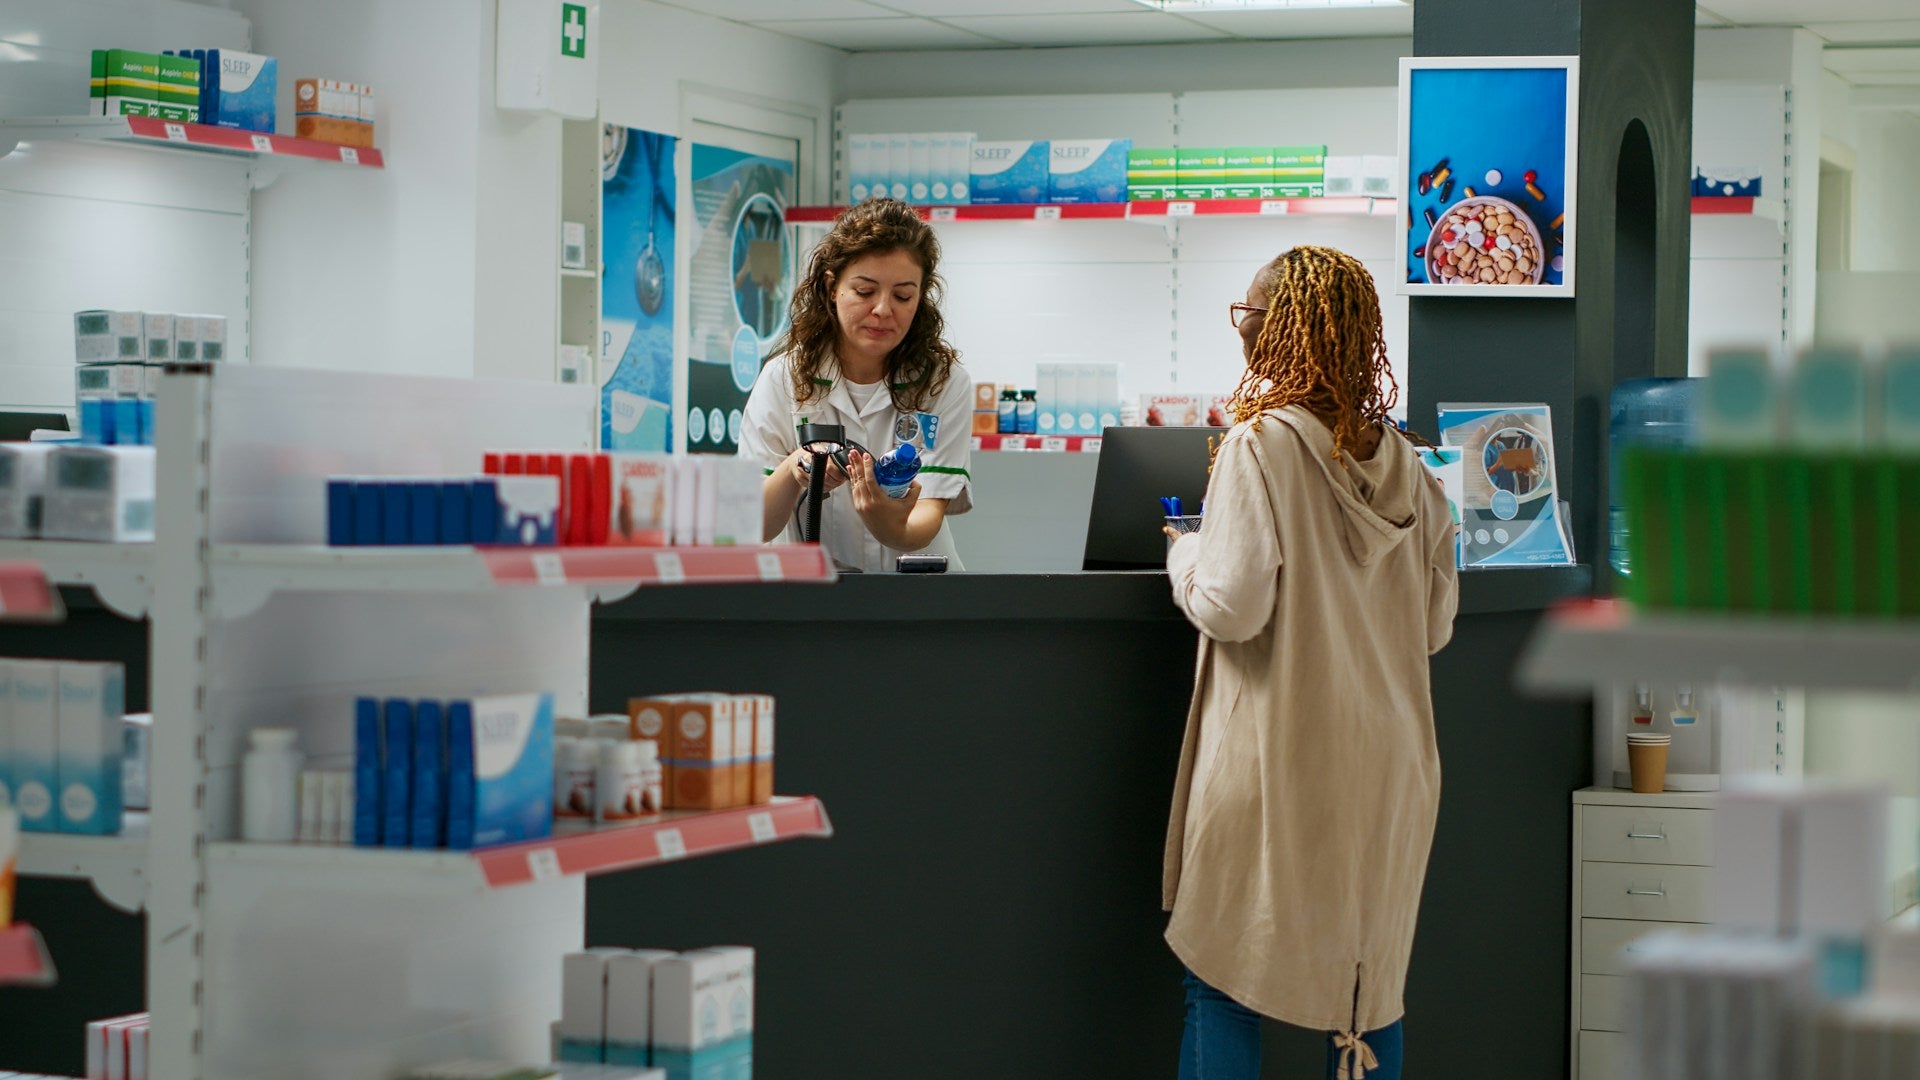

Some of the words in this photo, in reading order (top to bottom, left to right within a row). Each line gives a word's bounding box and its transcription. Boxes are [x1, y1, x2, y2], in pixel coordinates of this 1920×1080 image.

[123, 62, 143, 72] Aspirin
[223, 58, 251, 75] SLEEP
[161, 68, 182, 78] Aspirin
[150, 106, 159, 117] 30
[190, 112, 199, 122] 30
[975, 148, 1011, 160] SLEEP
[1053, 147, 1090, 159] SLEEP
[1165, 189, 1176, 198] 30
[1214, 189, 1226, 198] 30
[1263, 188, 1275, 197] 30
[1311, 188, 1323, 196] 30
[1151, 396, 1189, 404] CARDIO
